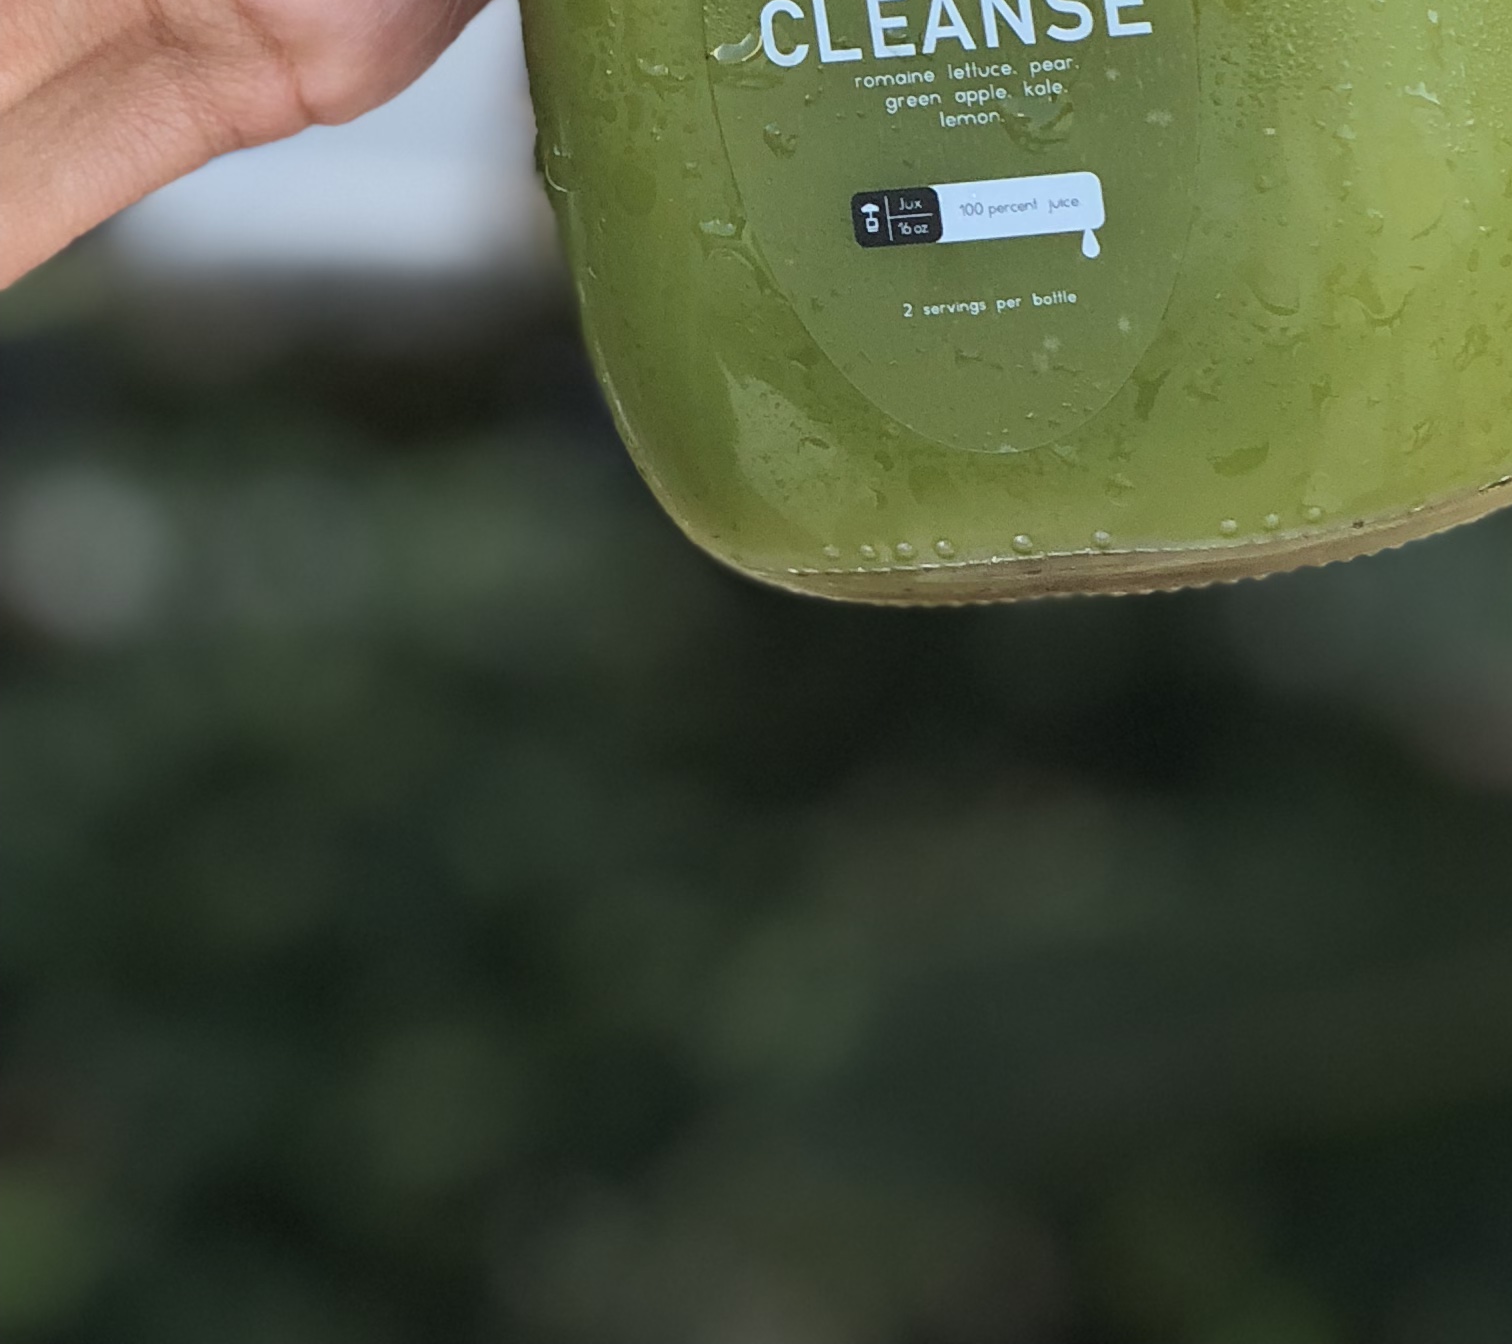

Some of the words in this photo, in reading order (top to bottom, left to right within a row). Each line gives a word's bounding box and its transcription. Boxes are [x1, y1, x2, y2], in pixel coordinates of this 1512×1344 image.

[885, 90, 942, 114] green
[959, 203, 984, 216] 100
[987, 198, 1038, 219] percent
[1047, 196, 1079, 214] juice
[913, 222, 929, 234] oz
[902, 303, 913, 317] 2
[923, 300, 987, 316] servings
[996, 296, 1022, 310] per
[1032, 290, 1078, 306] bottle
